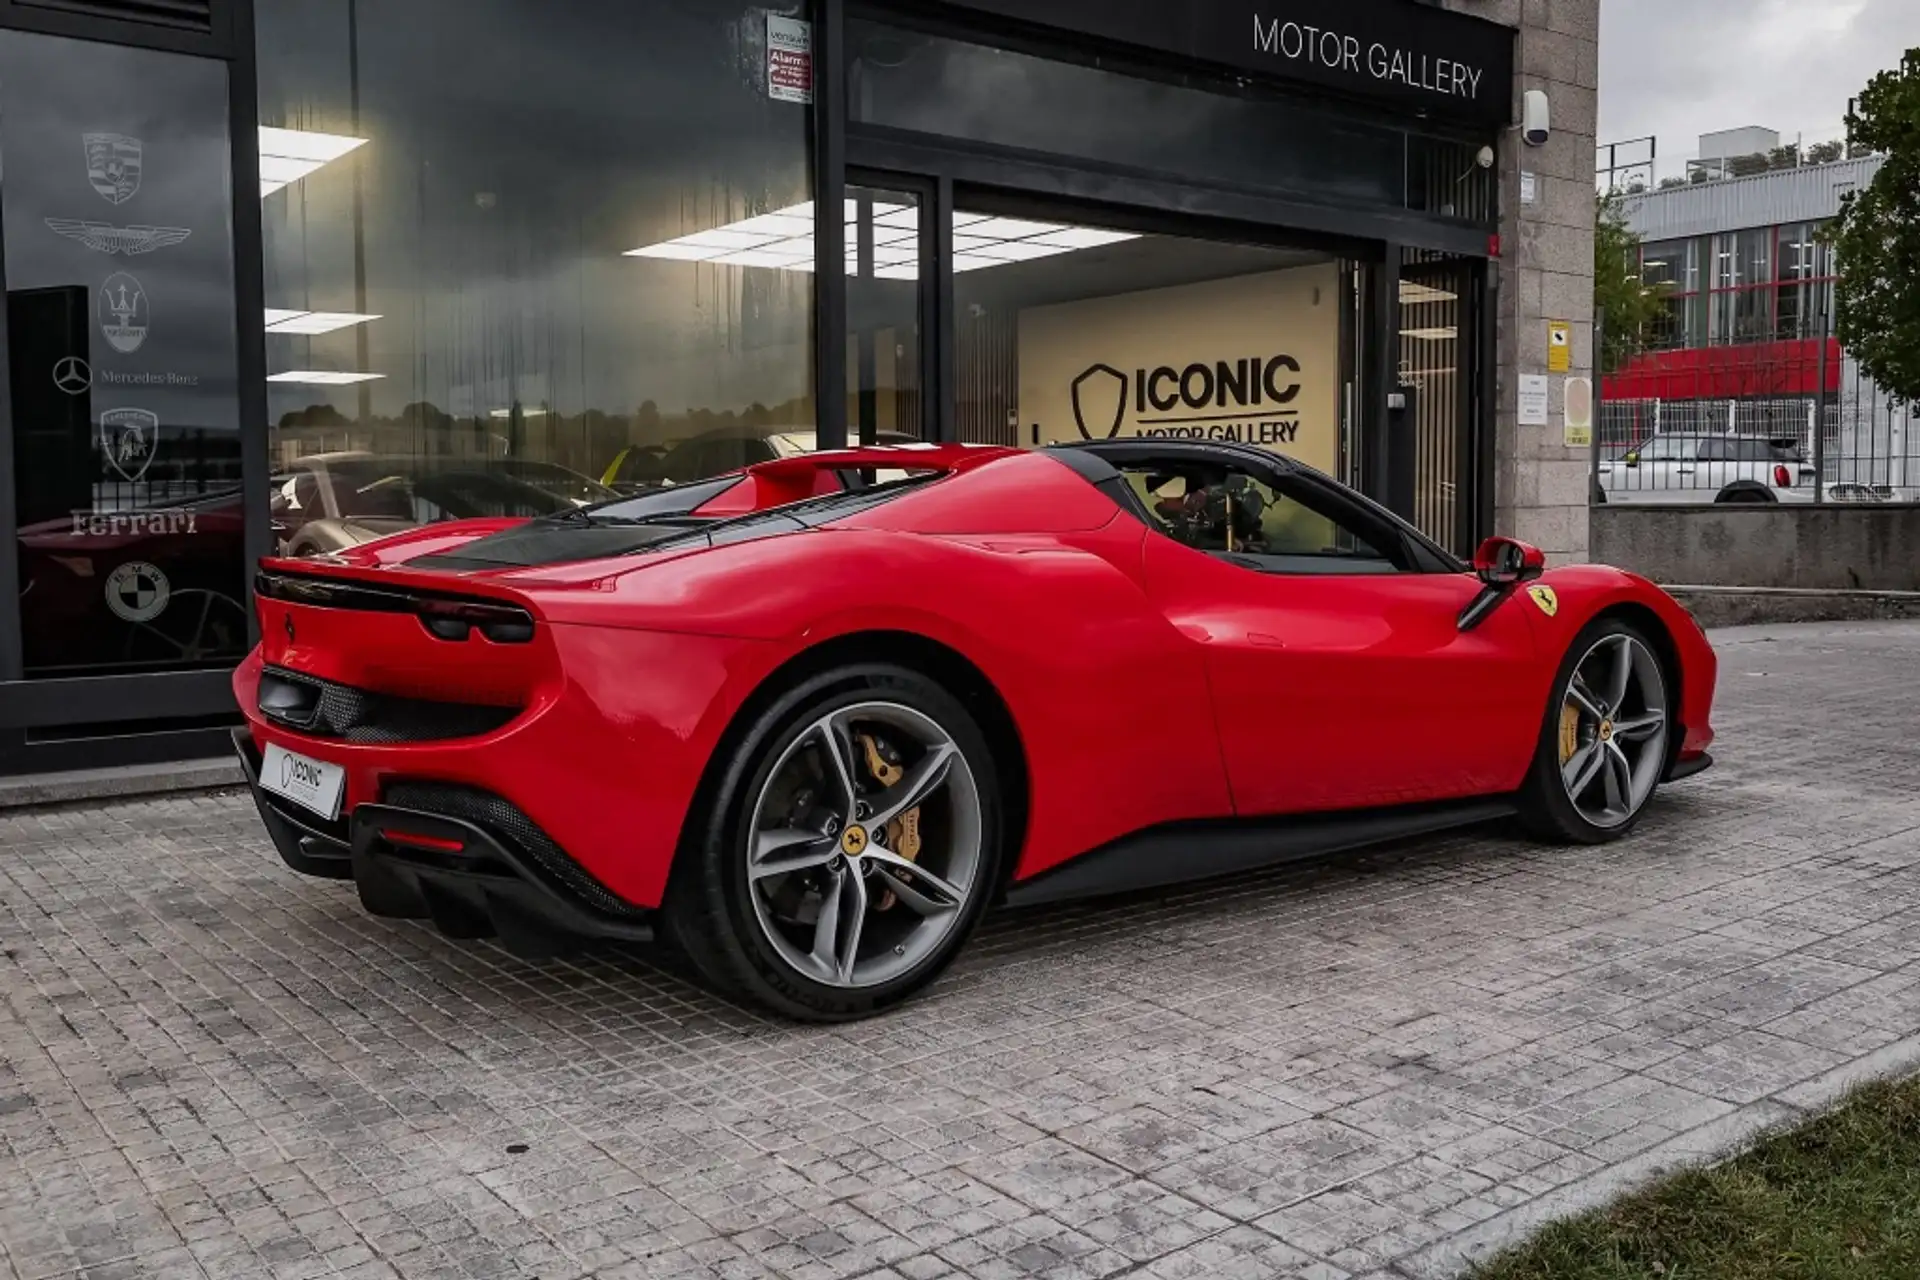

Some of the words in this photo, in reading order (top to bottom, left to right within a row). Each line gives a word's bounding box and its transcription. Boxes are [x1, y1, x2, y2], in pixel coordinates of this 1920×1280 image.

[1254, 13, 1359, 73] MOTOR
[1368, 43, 1483, 99] GALLERY
[101, 370, 199, 386] Mercedes-Benz
[1136, 354, 1301, 413] ICONIC
[1208, 420, 1299, 445] GALLERY
[70, 507, 198, 536] Ferrari
